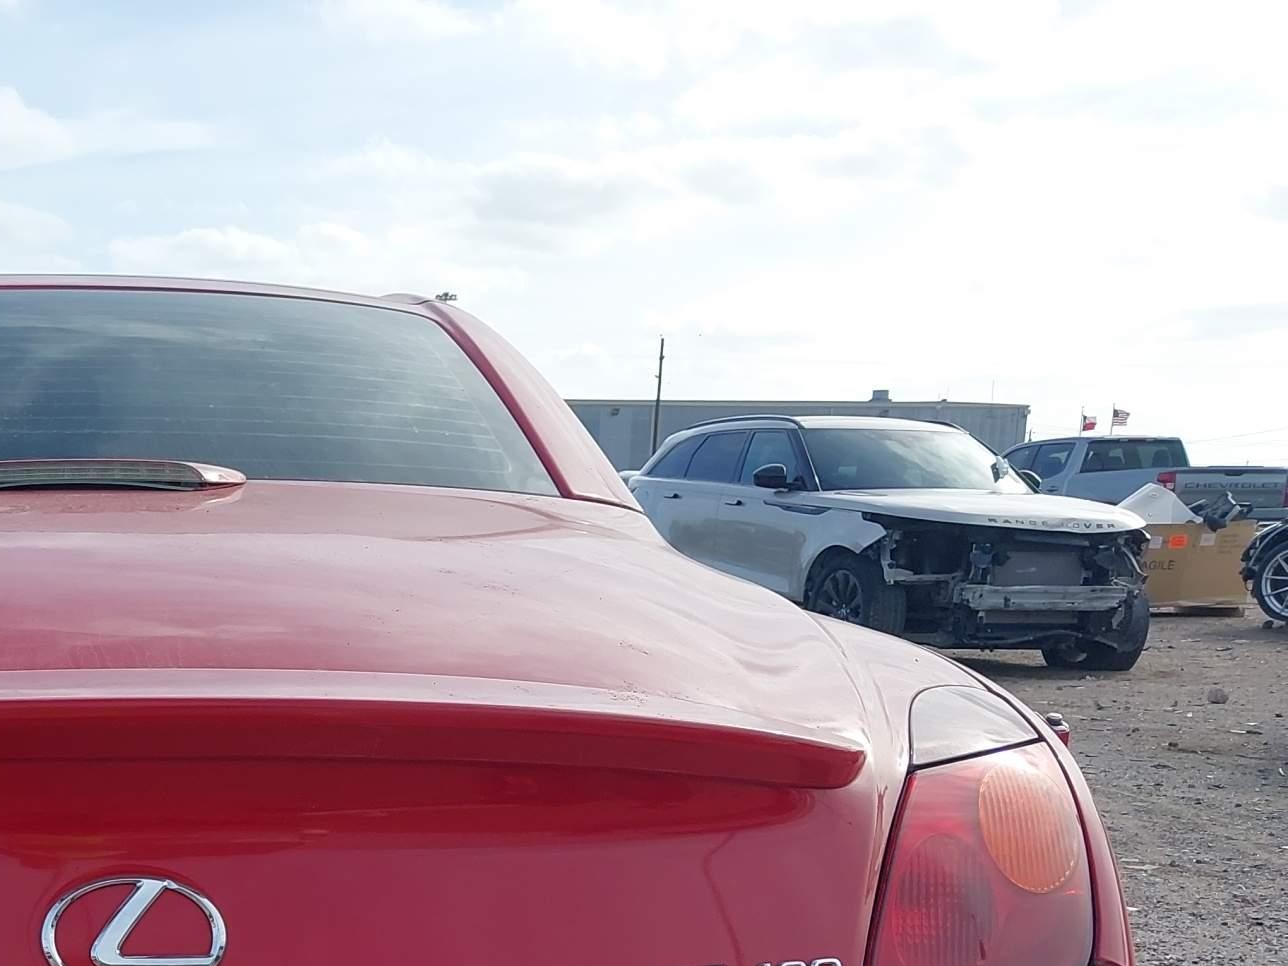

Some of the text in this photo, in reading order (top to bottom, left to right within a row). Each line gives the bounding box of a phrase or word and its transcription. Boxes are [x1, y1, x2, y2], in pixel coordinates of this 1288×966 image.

[987, 517, 1116, 529] RANGE OVER
[1142, 559, 1176, 571] AGILE
